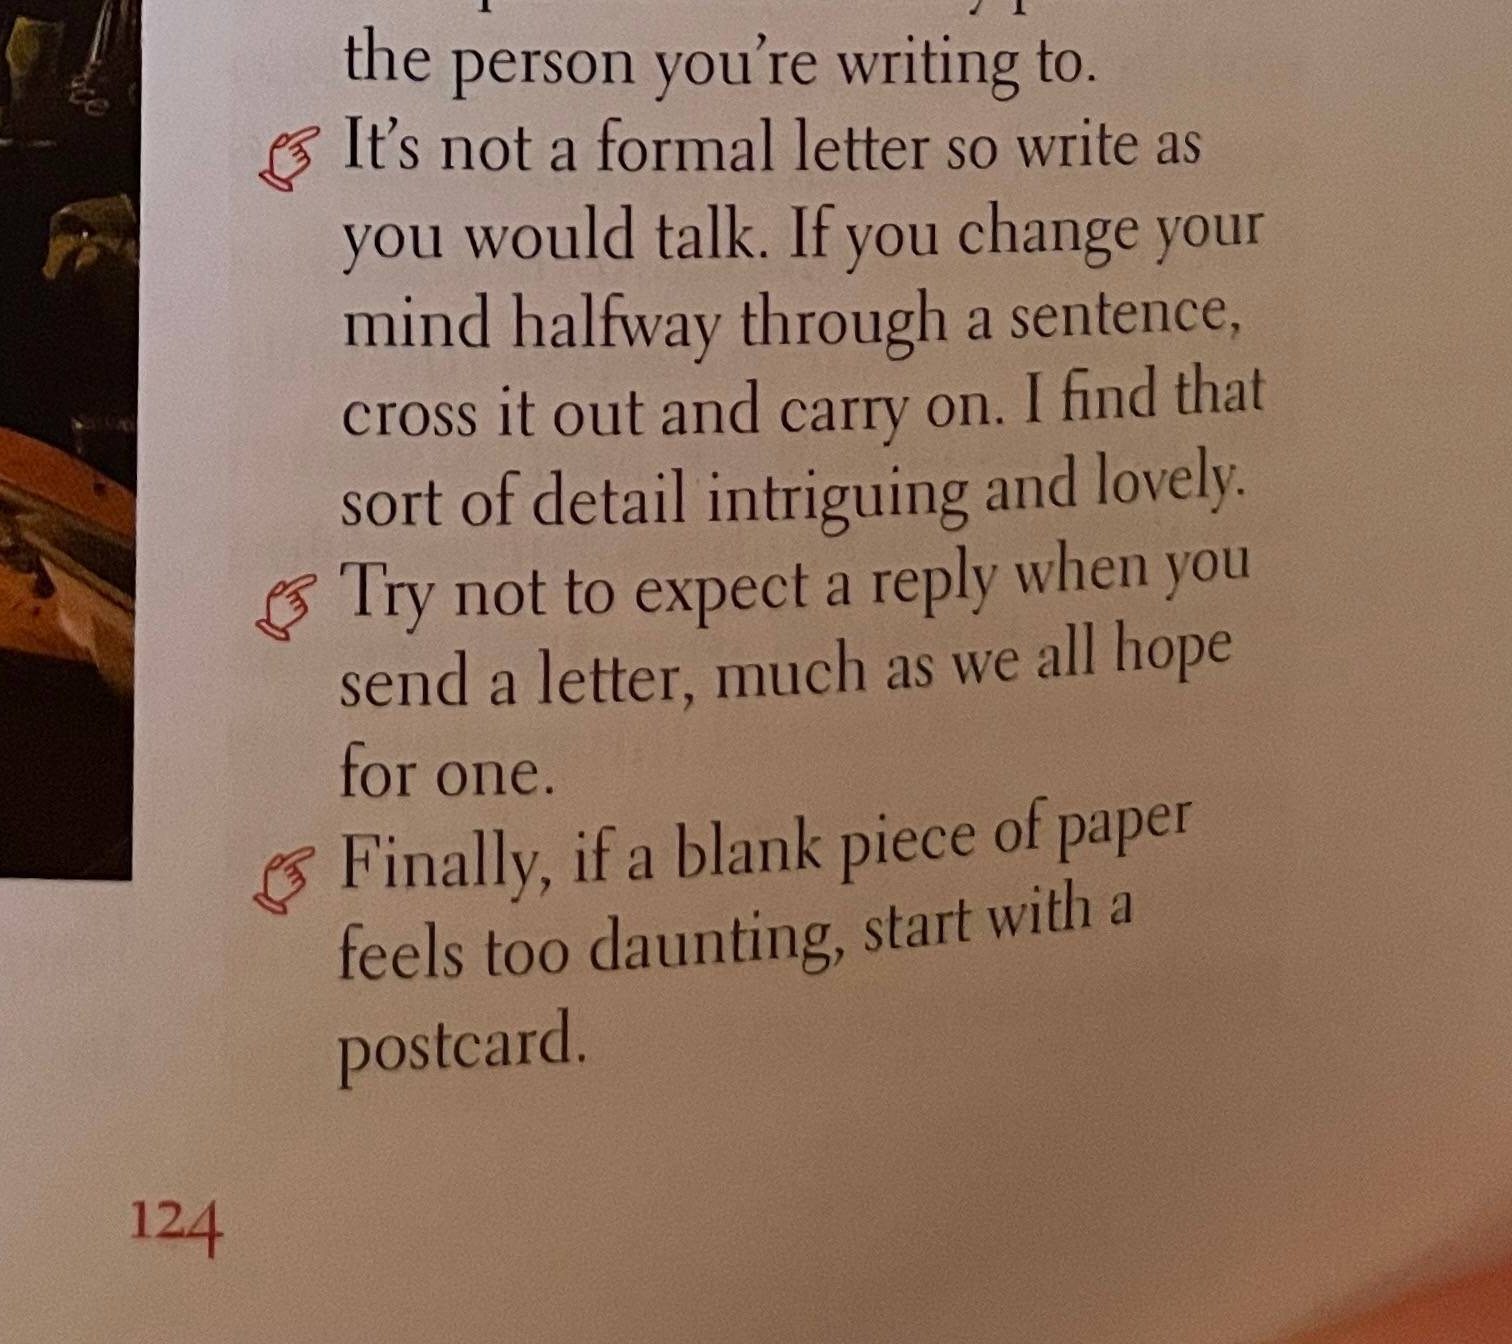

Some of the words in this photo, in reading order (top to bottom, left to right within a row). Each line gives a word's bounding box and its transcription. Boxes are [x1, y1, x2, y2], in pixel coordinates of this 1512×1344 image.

[343, 291, 491, 349] mind
[511, 291, 722, 365] halfway
[740, 287, 949, 362] through
[967, 306, 993, 341] a
[1010, 291, 1241, 340] sentence,
[341, 479, 444, 527] sort
[461, 469, 522, 527] of
[532, 467, 686, 526] detail
[708, 464, 969, 539] intriguing
[985, 452, 1078, 512] and
[1095, 444, 1245, 515] lovely.
[340, 740, 418, 799] for
[436, 759, 554, 797] one.
[338, 920, 464, 982] feels
[484, 929, 570, 978] too
[589, 909, 845, 977] daunting,
[864, 898, 974, 953] start
[986, 877, 1092, 940] with
[1110, 891, 1132, 927] a
[337, 1006, 586, 1092] postcard.
[131, 1199, 225, 1261] 124
